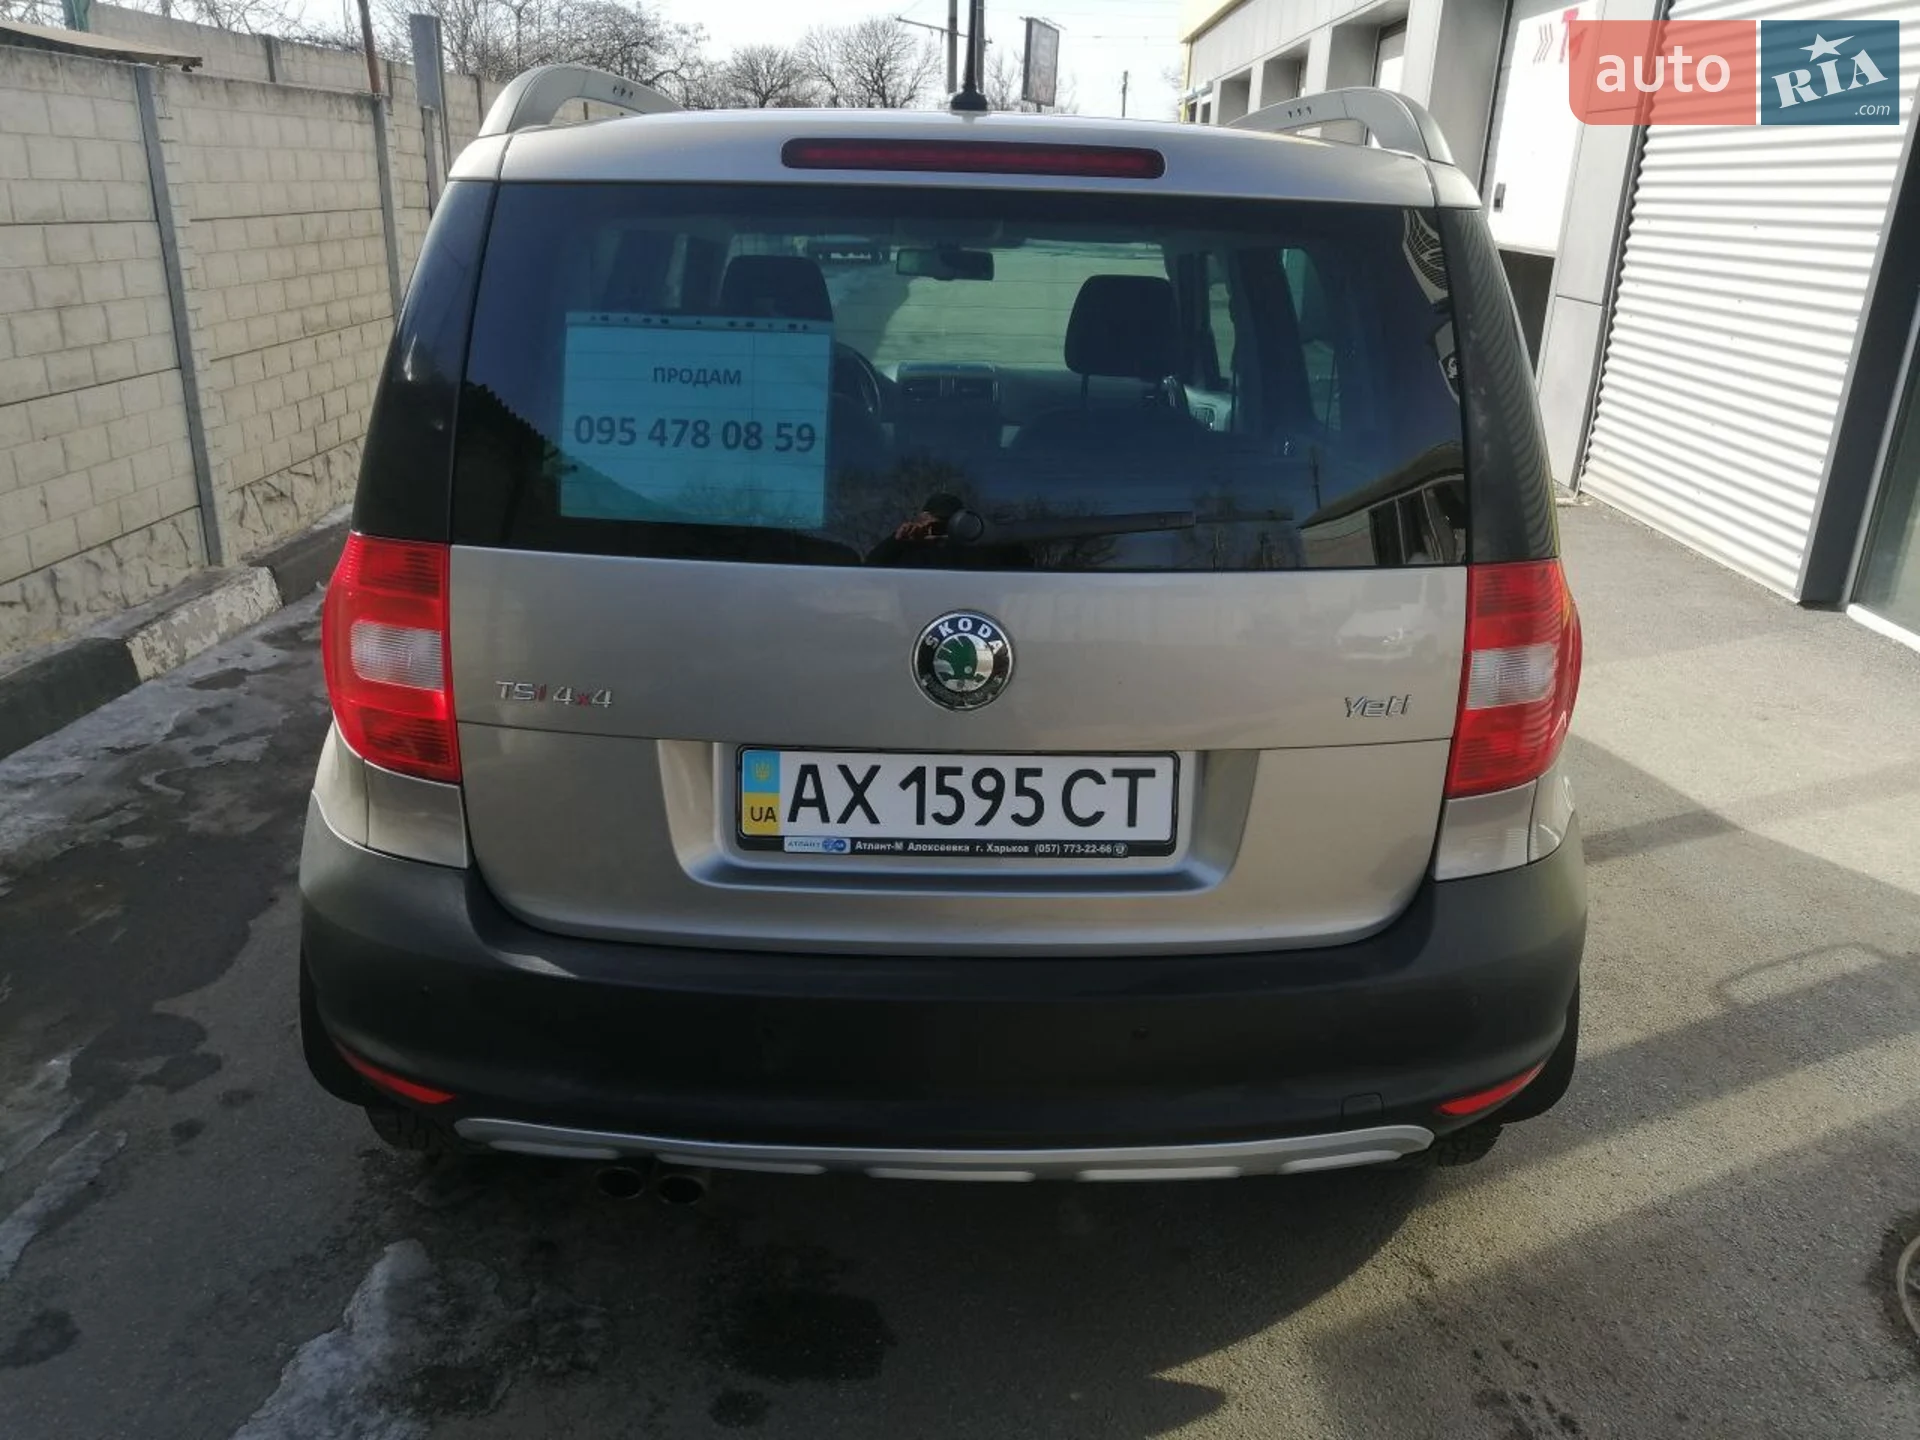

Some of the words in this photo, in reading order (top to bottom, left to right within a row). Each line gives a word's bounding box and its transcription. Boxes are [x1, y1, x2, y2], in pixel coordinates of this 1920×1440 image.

[653, 366, 742, 387] ПРОДАМ
[574, 415, 637, 446] 095
[648, 417, 711, 449] 478
[721, 420, 763, 451] 08
[774, 422, 816, 452] 59
[787, 764, 882, 825] AX
[898, 766, 1045, 827] 1595
[1061, 768, 1156, 828] CT
[750, 806, 777, 822] UA
[986, 843, 1029, 854] Харьков
[1034, 844, 1060, 855] (057)
